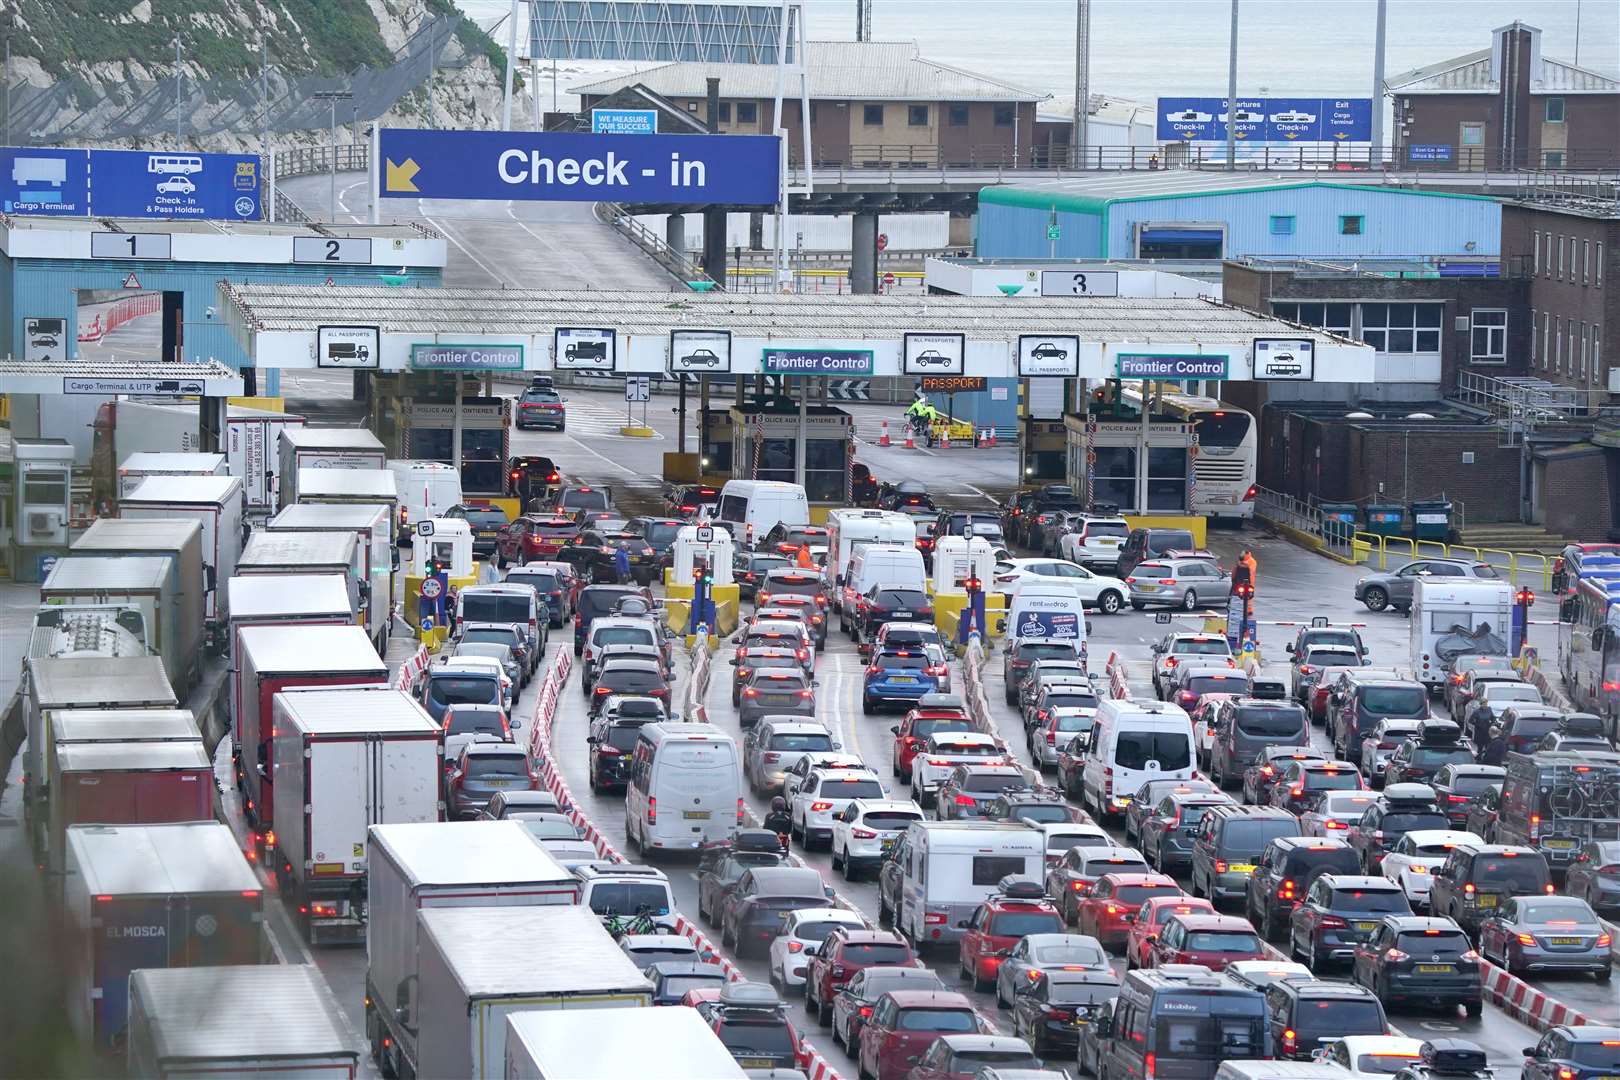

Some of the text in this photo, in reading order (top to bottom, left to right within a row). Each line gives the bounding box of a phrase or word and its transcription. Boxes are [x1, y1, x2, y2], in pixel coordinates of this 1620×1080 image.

[612, 115, 648, 123] MEASURE
[498, 149, 630, 186] Check
[671, 152, 706, 186] in
[155, 196, 179, 205] Check
[188, 197, 196, 205] In
[13, 202, 75, 212] Cargo Terminal
[126, 235, 137, 256] 1
[326, 240, 340, 260] 2
[1072, 274, 1087, 294] 3
[416, 351, 520, 364] Frontier Control
[768, 356, 870, 368] Frontier Control
[1122, 360, 1224, 374] Frontier Control
[923, 378, 982, 389] PASSPORT
[504, 400, 510, 408] 2
[758, 414, 763, 422] 3
[107, 926, 166, 937] EL MOSCA
[1164, 1002, 1198, 1011] Hobby
